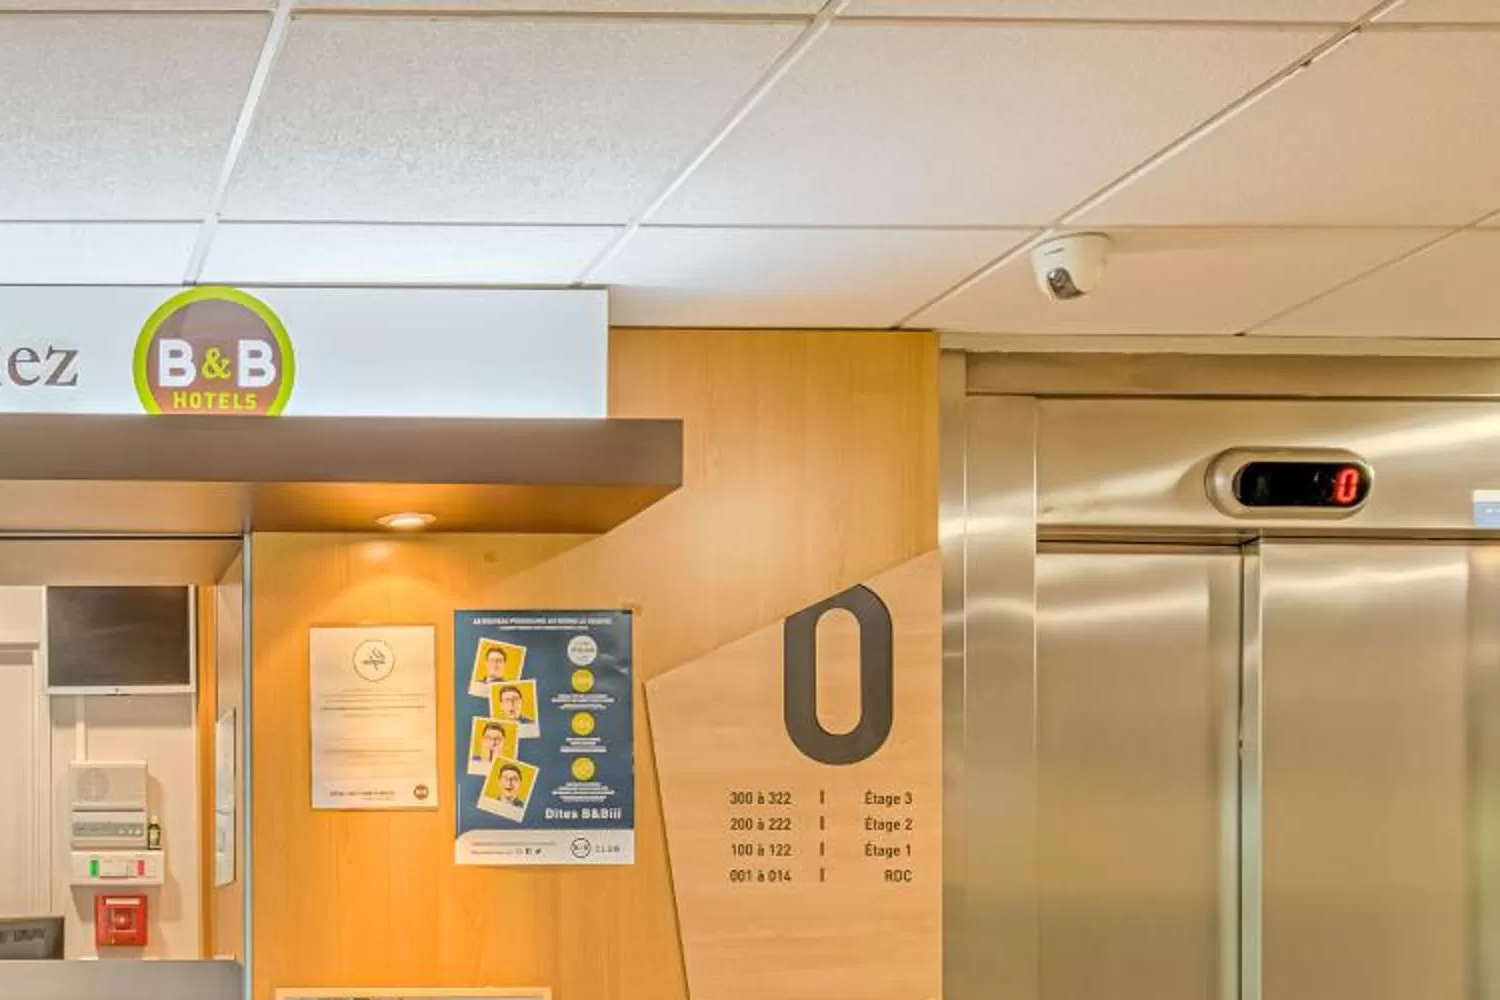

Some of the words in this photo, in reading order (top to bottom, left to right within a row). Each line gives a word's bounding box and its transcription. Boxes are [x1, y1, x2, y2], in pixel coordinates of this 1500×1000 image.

[158, 338, 277, 388] B&B
[173, 392, 257, 410] HOTELS
[1334, 467, 1360, 503] 0
[784, 584, 893, 765] 0
[729, 791, 753, 805] 300
[768, 791, 792, 805] 322
[864, 788, 901, 808] Étage
[904, 791, 913, 805] 3
[729, 817, 753, 831] 200
[768, 817, 792, 831] 222
[864, 814, 901, 833] Étage
[904, 817, 913, 831] 2
[731, 843, 753, 857] 100
[769, 843, 792, 857] 122
[864, 840, 901, 859] Étage
[905, 843, 912, 857] 1
[729, 869, 752, 882] 001
[767, 869, 792, 882] 014
[883, 868, 913, 882] RDC
